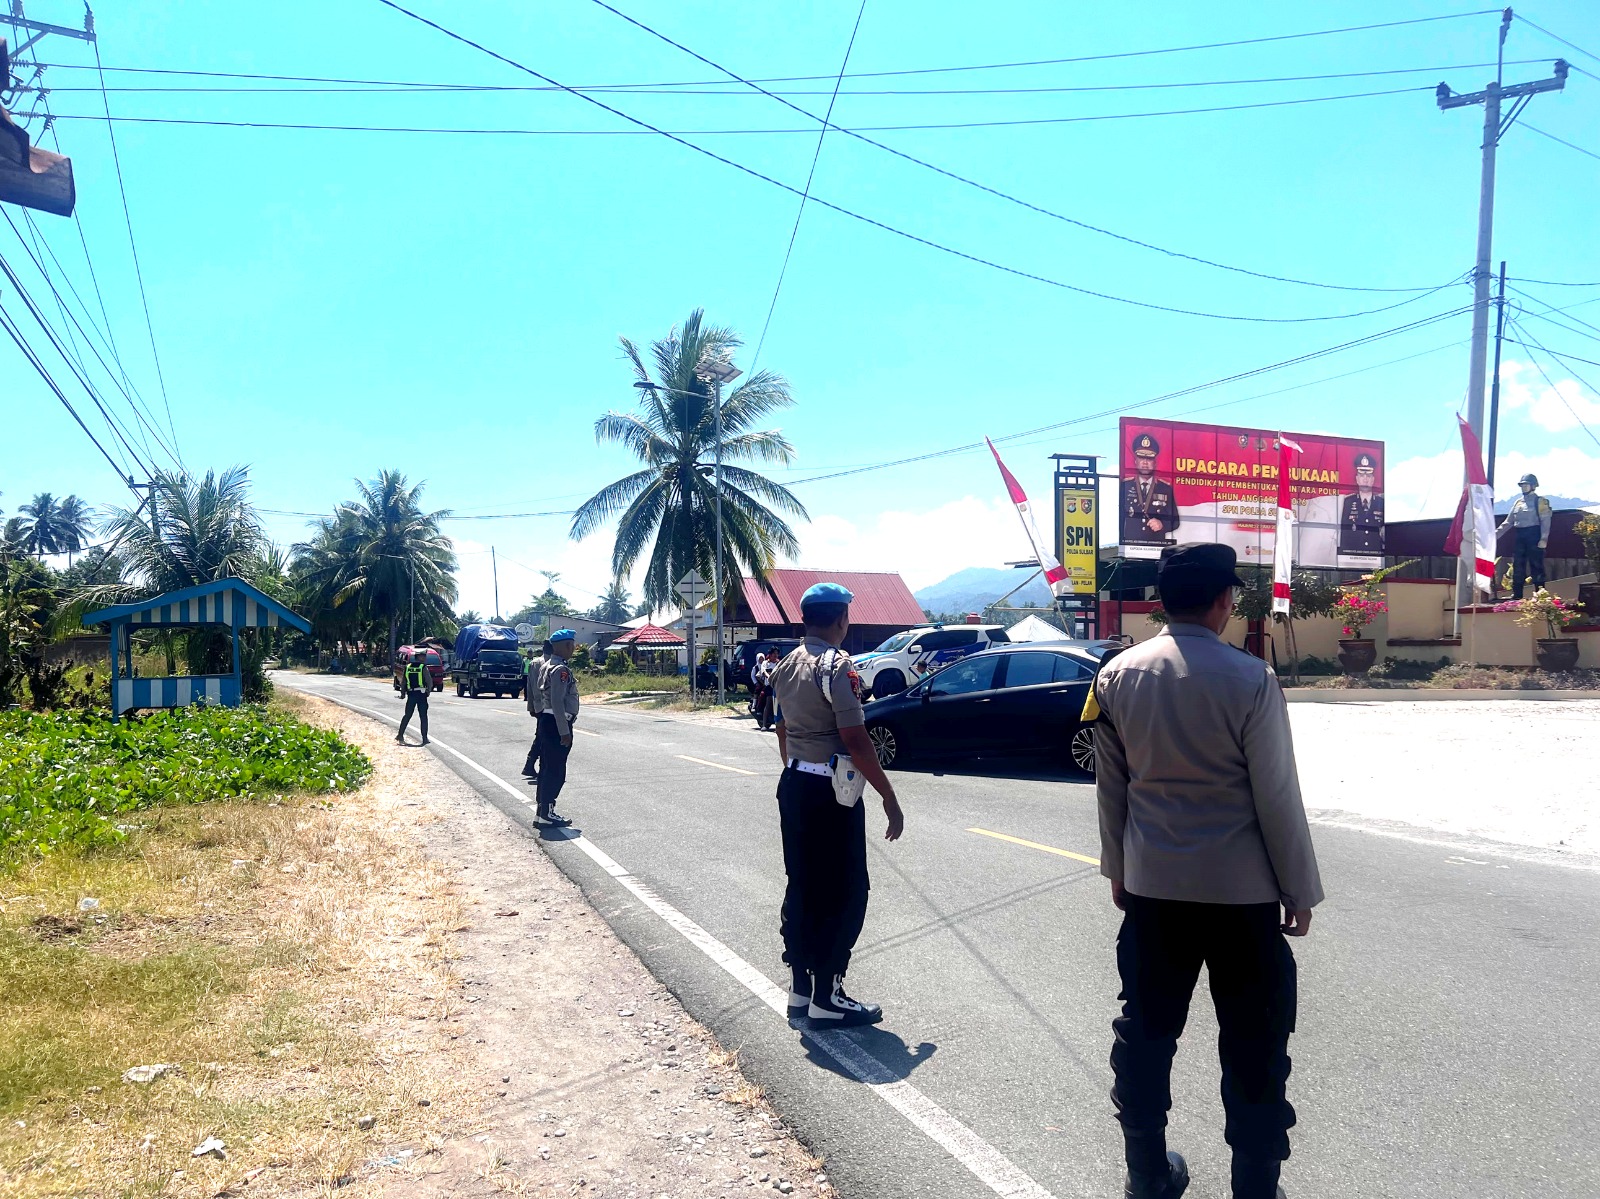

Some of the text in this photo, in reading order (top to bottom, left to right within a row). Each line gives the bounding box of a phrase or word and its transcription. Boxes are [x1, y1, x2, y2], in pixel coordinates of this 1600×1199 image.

[1175, 458, 1249, 477] UPACARA
[1175, 477, 1224, 488] PENDIDIKAN
[1288, 485, 1316, 494] INTARA
[1318, 487, 1340, 496] POLRI
[1212, 492, 1239, 501] TAHUN
[1240, 494, 1278, 504] ANGGARA
[1222, 505, 1238, 514] SPN
[1239, 506, 1267, 516] POLDA
[1066, 526, 1093, 546] SPN
